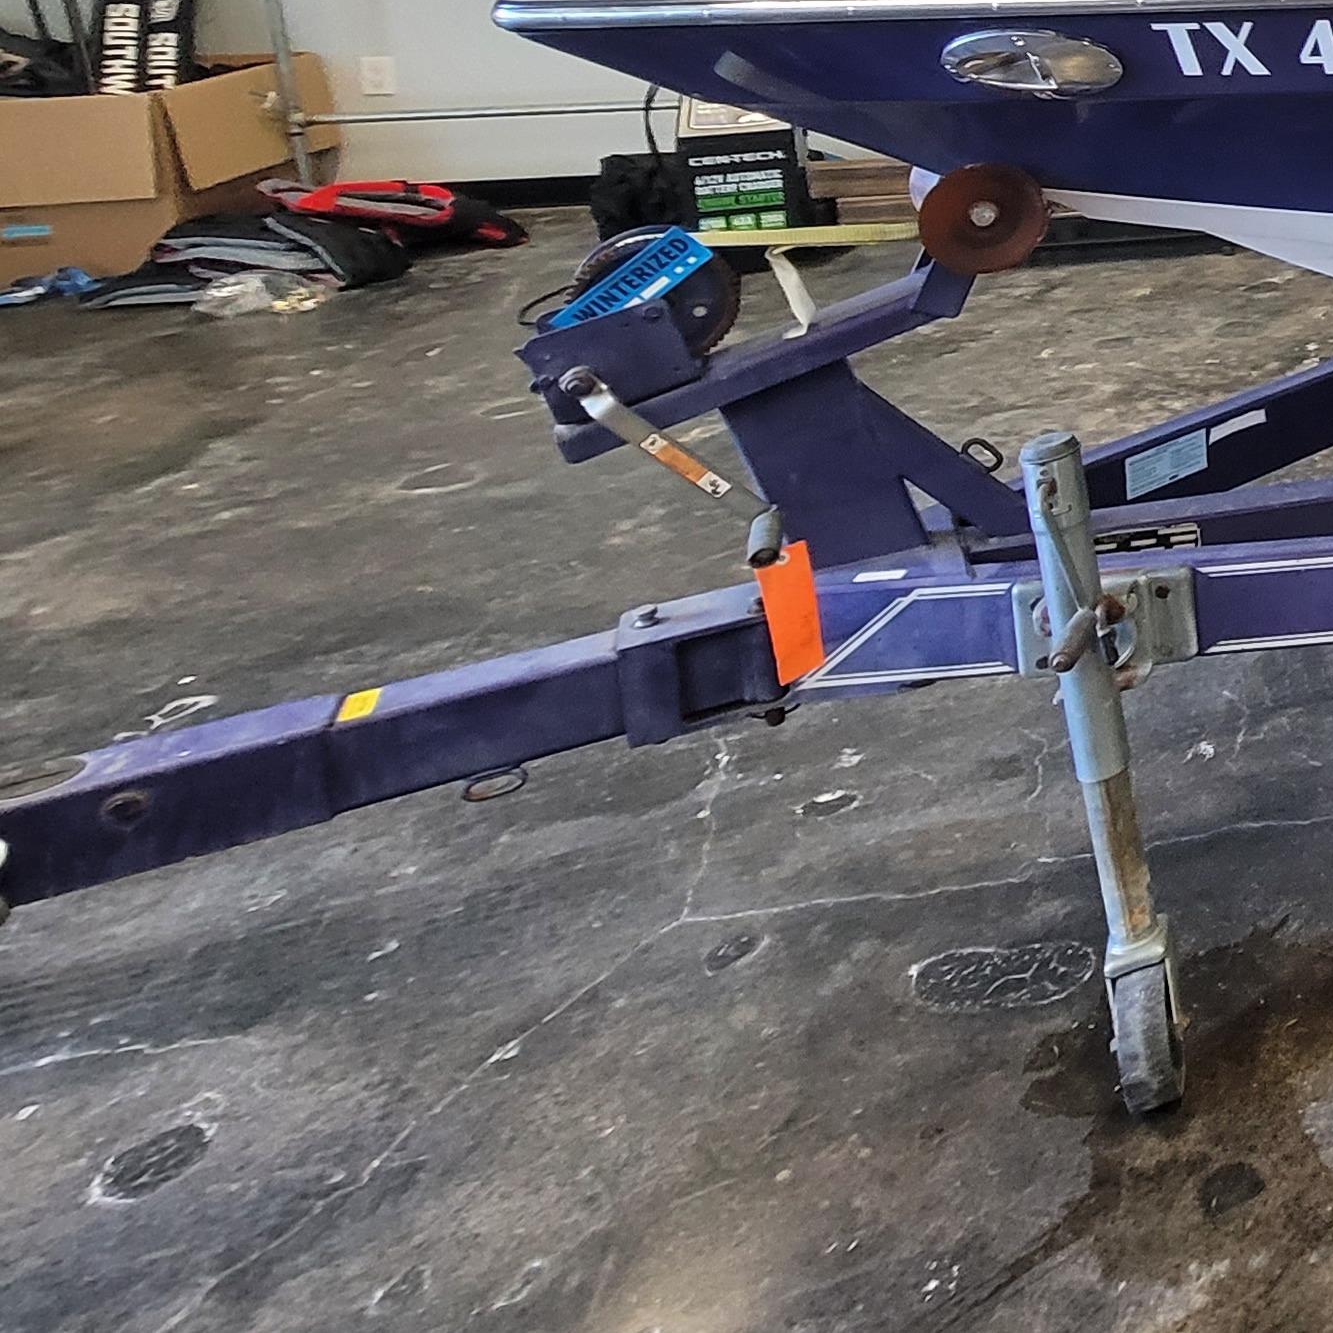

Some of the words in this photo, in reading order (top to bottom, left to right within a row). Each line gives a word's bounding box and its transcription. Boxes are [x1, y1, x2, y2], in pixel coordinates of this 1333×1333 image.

[98, 3, 141, 96] SOUTHW
[145, 32, 180, 90] SOUT
[1150, 21, 1272, 76] TX
[572, 238, 689, 321] WINTERIZED
